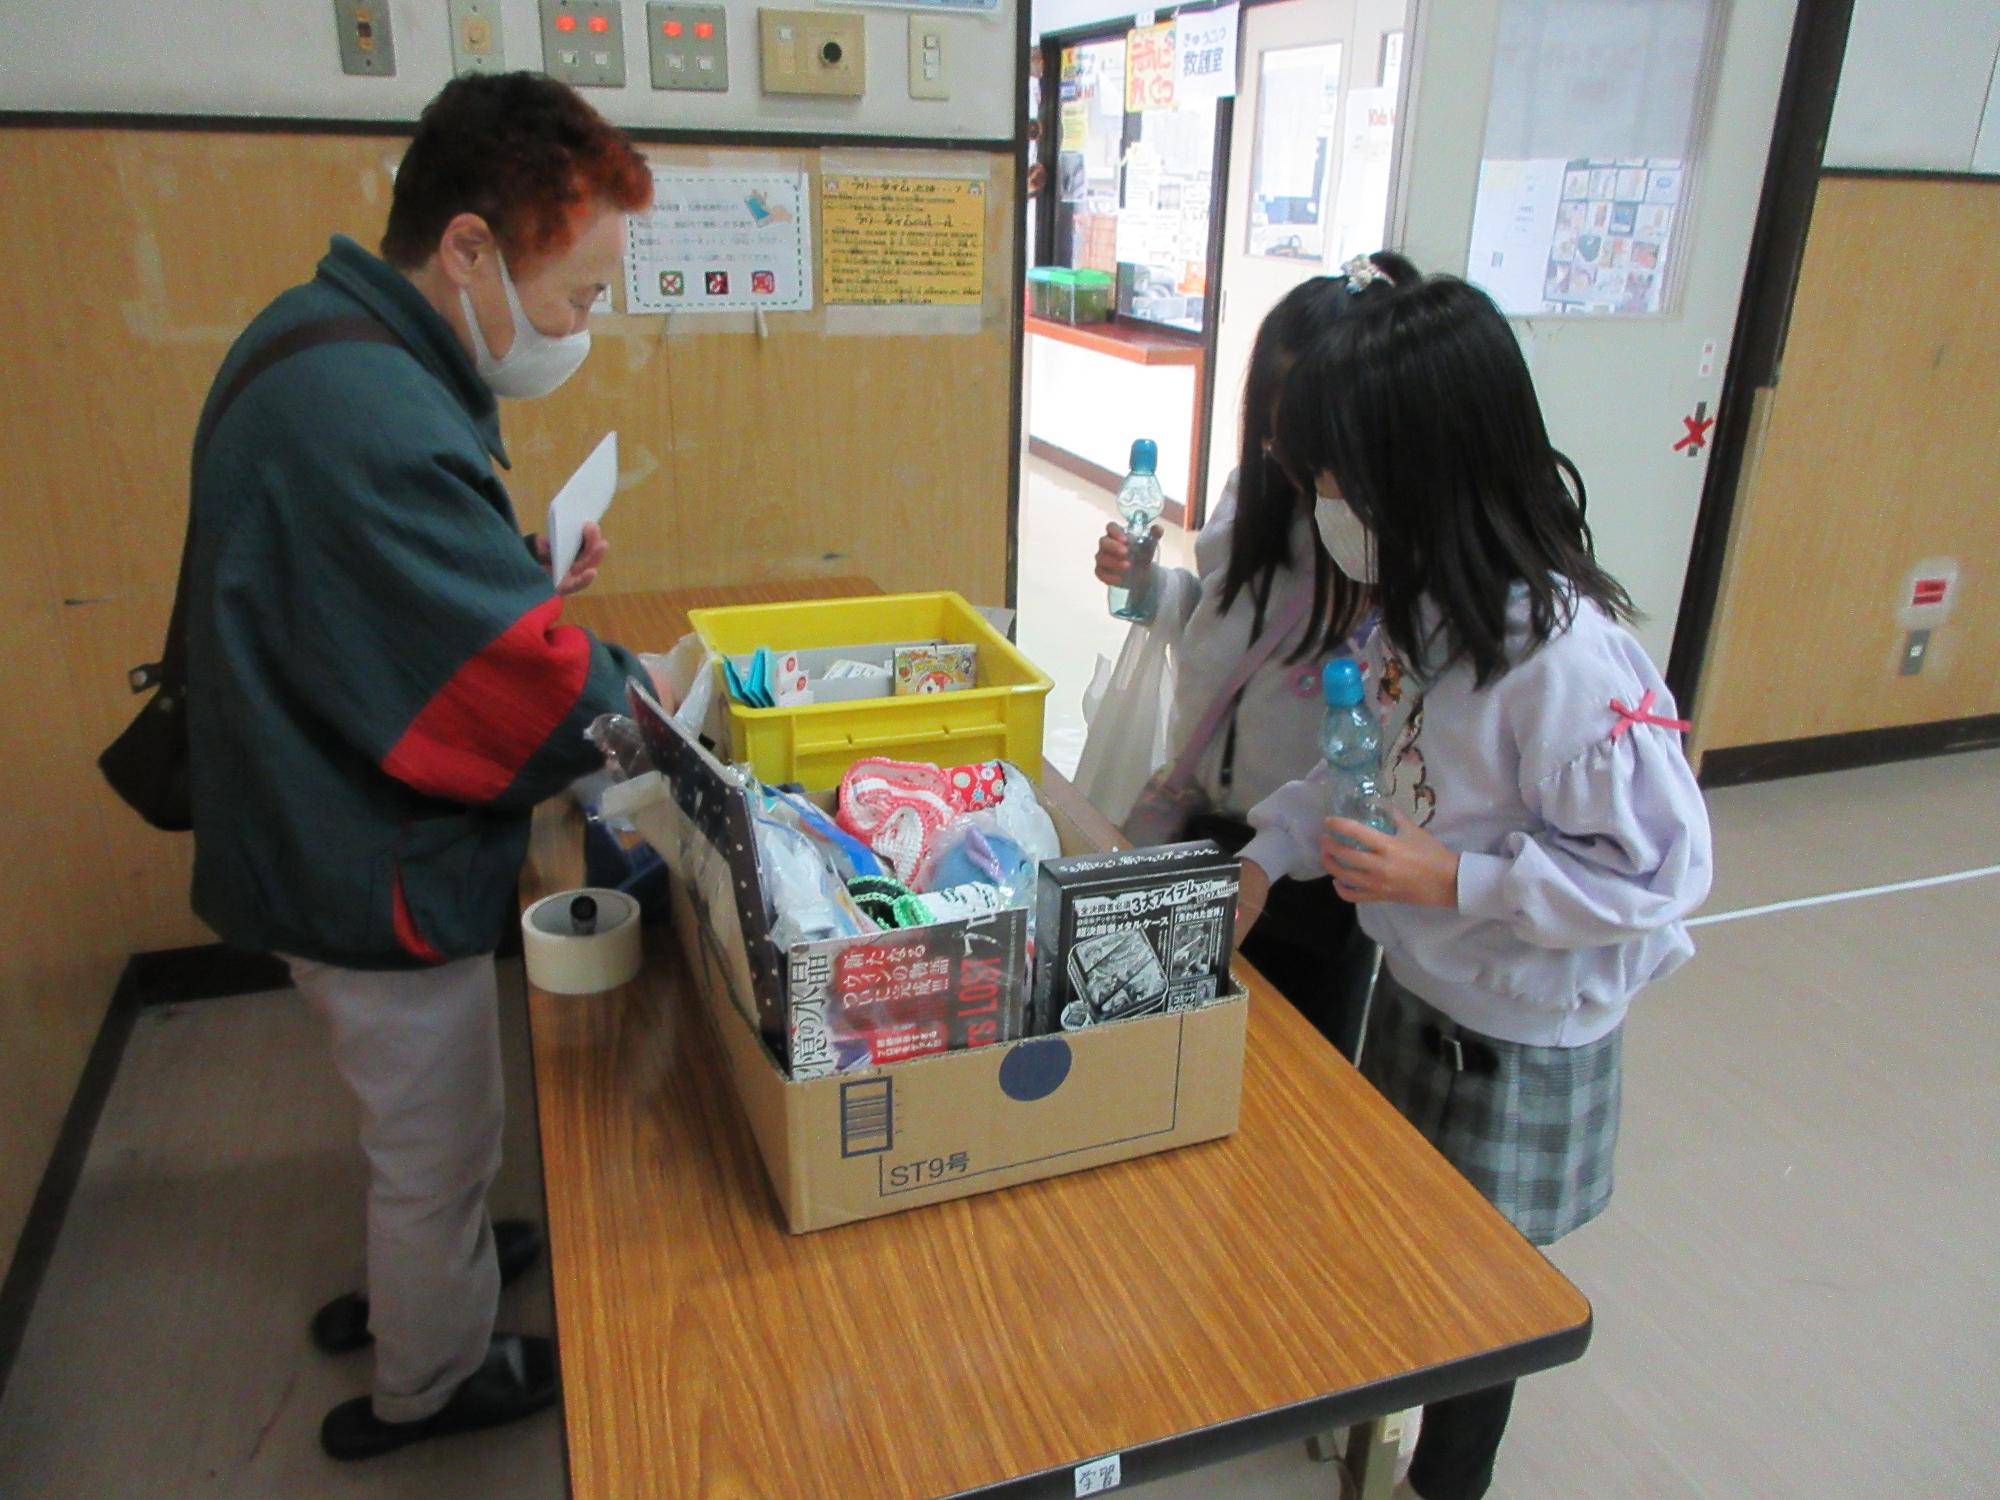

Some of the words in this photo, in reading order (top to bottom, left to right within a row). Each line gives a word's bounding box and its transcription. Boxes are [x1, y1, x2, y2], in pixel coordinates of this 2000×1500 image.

[844, 944, 927, 969] 新たなる
[958, 957, 1002, 1017] LOST
[792, 952, 833, 1079] 憶の水晶
[890, 1151, 970, 1187] ST9号
